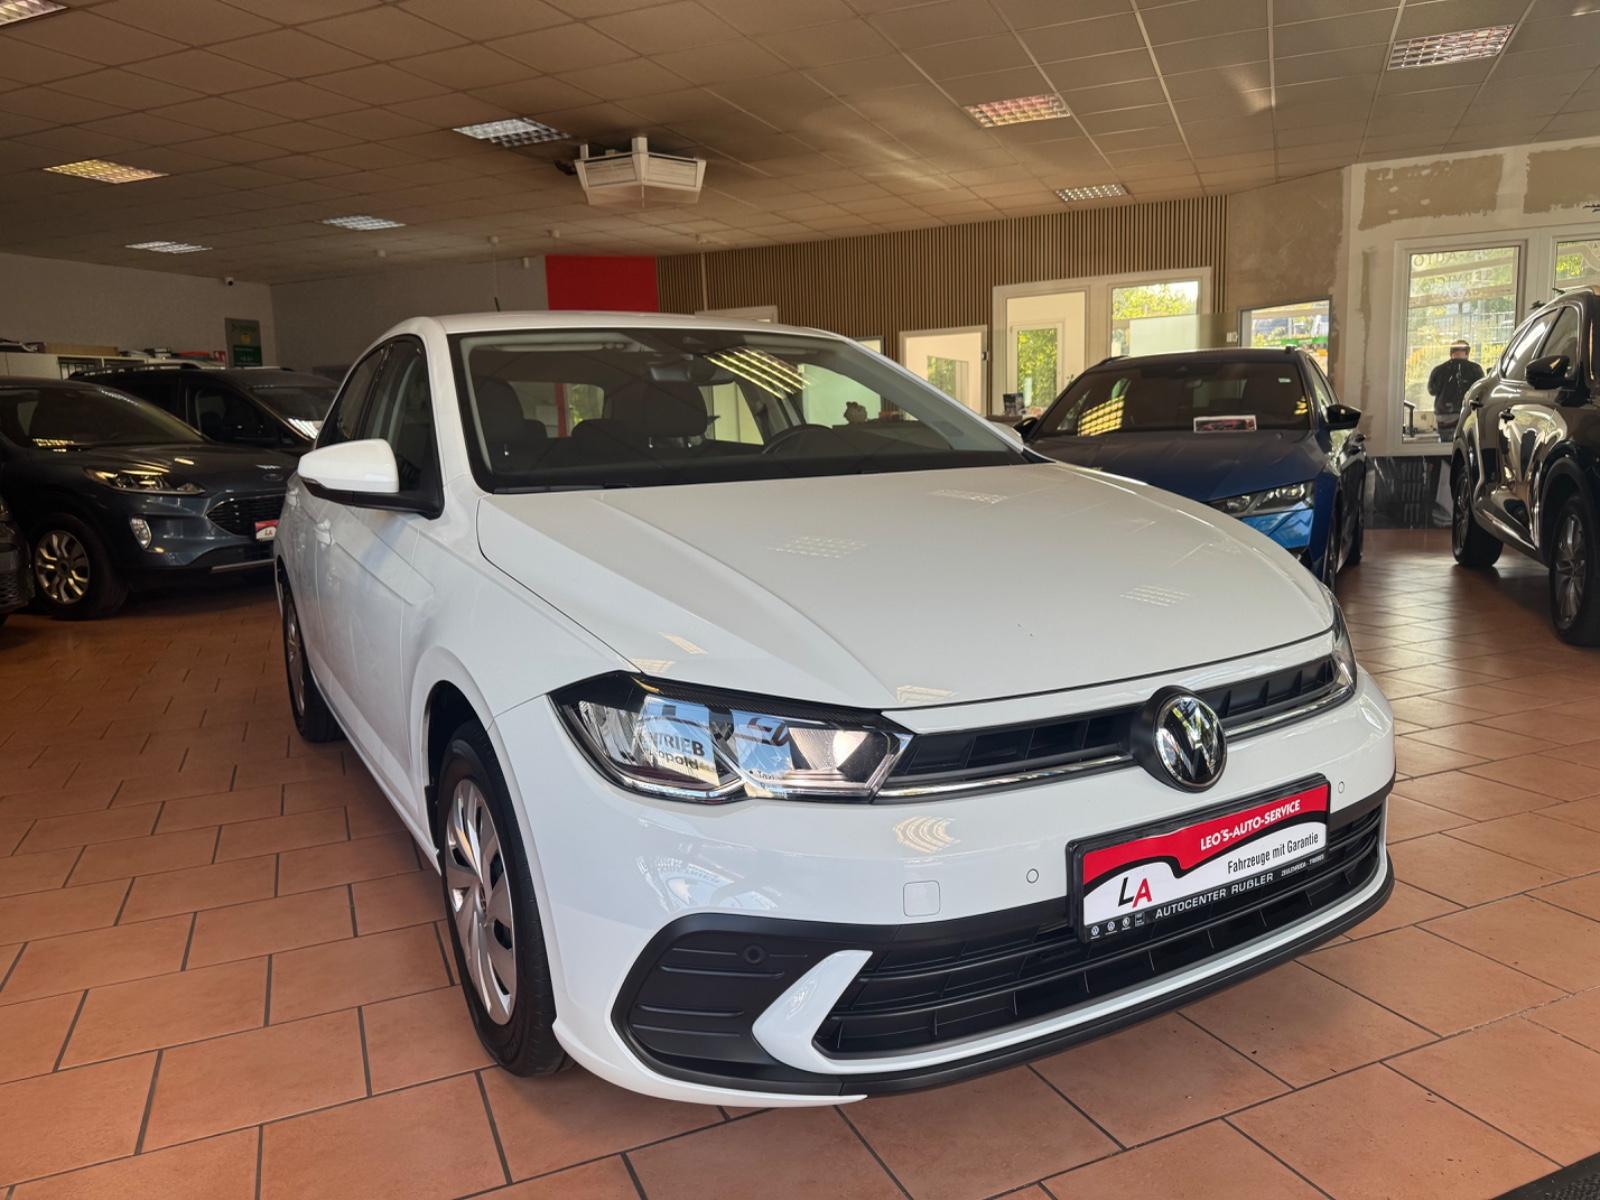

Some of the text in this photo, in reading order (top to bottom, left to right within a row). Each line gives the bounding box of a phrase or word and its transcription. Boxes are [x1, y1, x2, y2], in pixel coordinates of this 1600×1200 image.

[1227, 832, 1319, 875] Fahrzeuge mit Garantie
[1118, 877, 1153, 908] LA
[1155, 888, 1227, 919] AUTOCENTER
